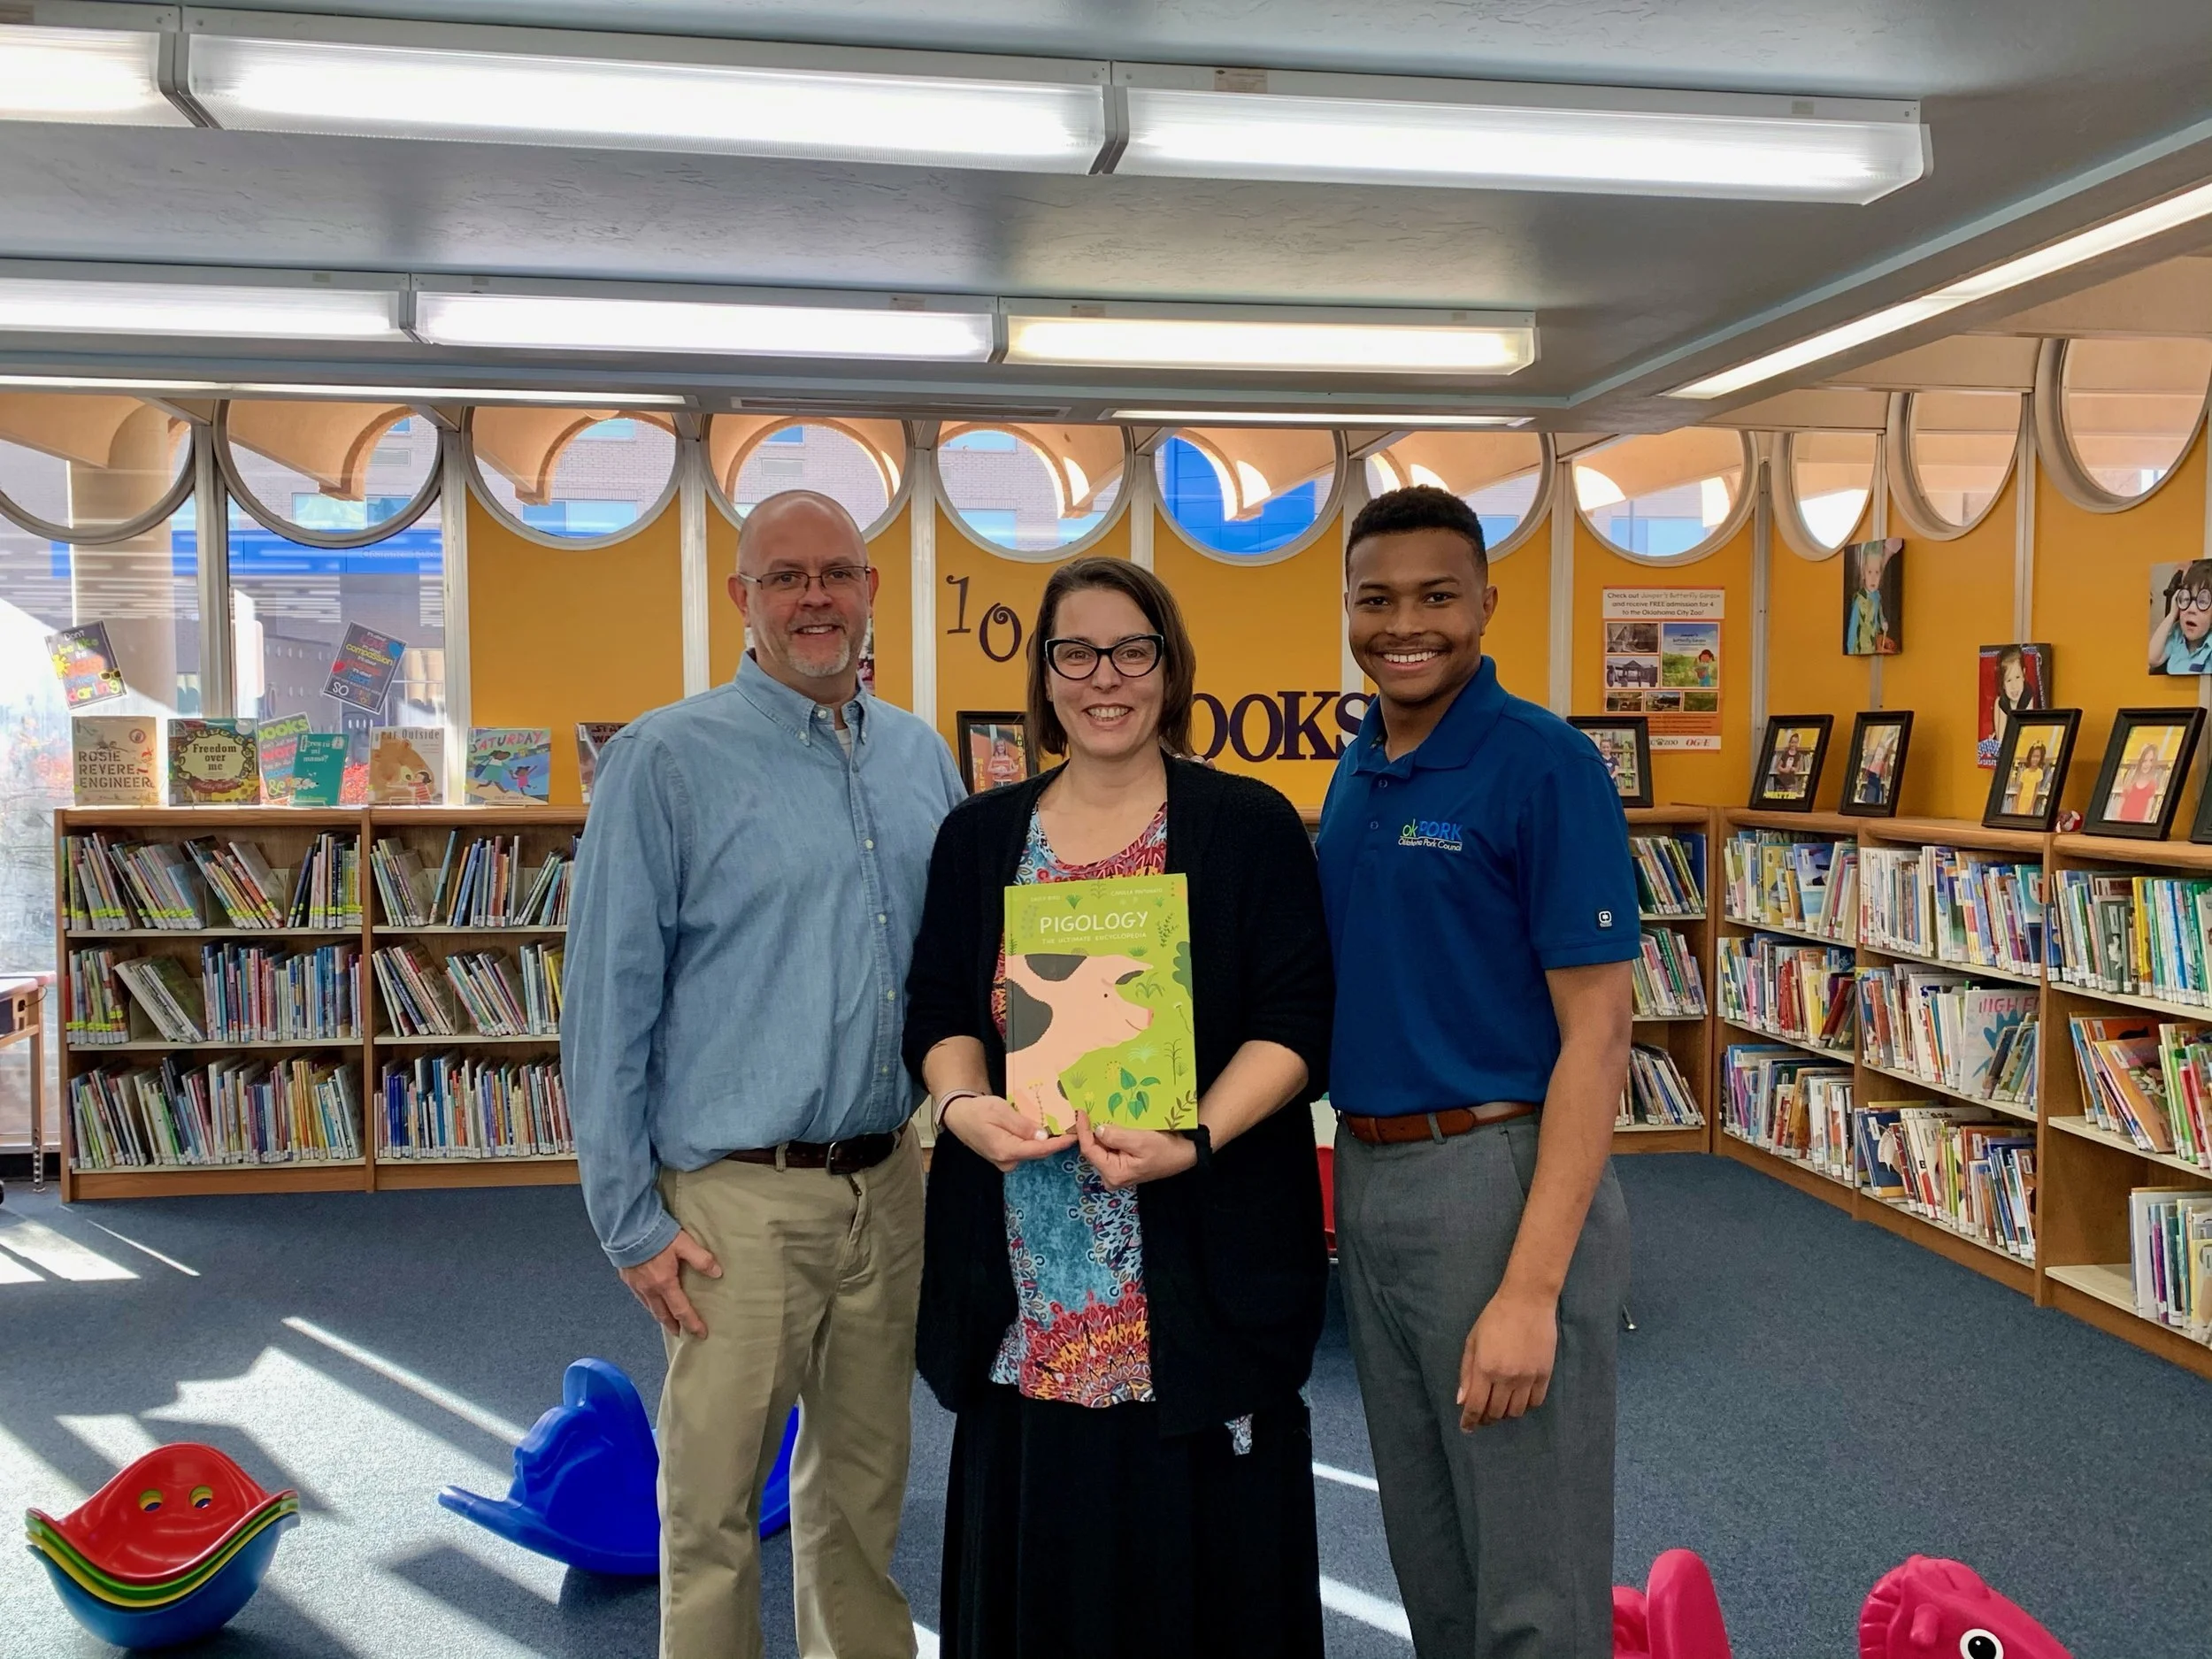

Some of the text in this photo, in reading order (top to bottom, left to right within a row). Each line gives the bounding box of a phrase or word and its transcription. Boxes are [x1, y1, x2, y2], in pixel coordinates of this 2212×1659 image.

[333, 681, 349, 696] SO
[402, 729, 440, 740] Outside
[193, 743, 237, 753] Freedom
[470, 731, 543, 754] SATURDAY
[79, 751, 121, 763] ROSIE
[80, 777, 150, 788] ENGINEER
[1040, 911, 1148, 934] PIGOLOGY
[1058, 935, 1091, 944] ULTIMATE
[1094, 933, 1147, 941] ENCYCLOPEDIA
